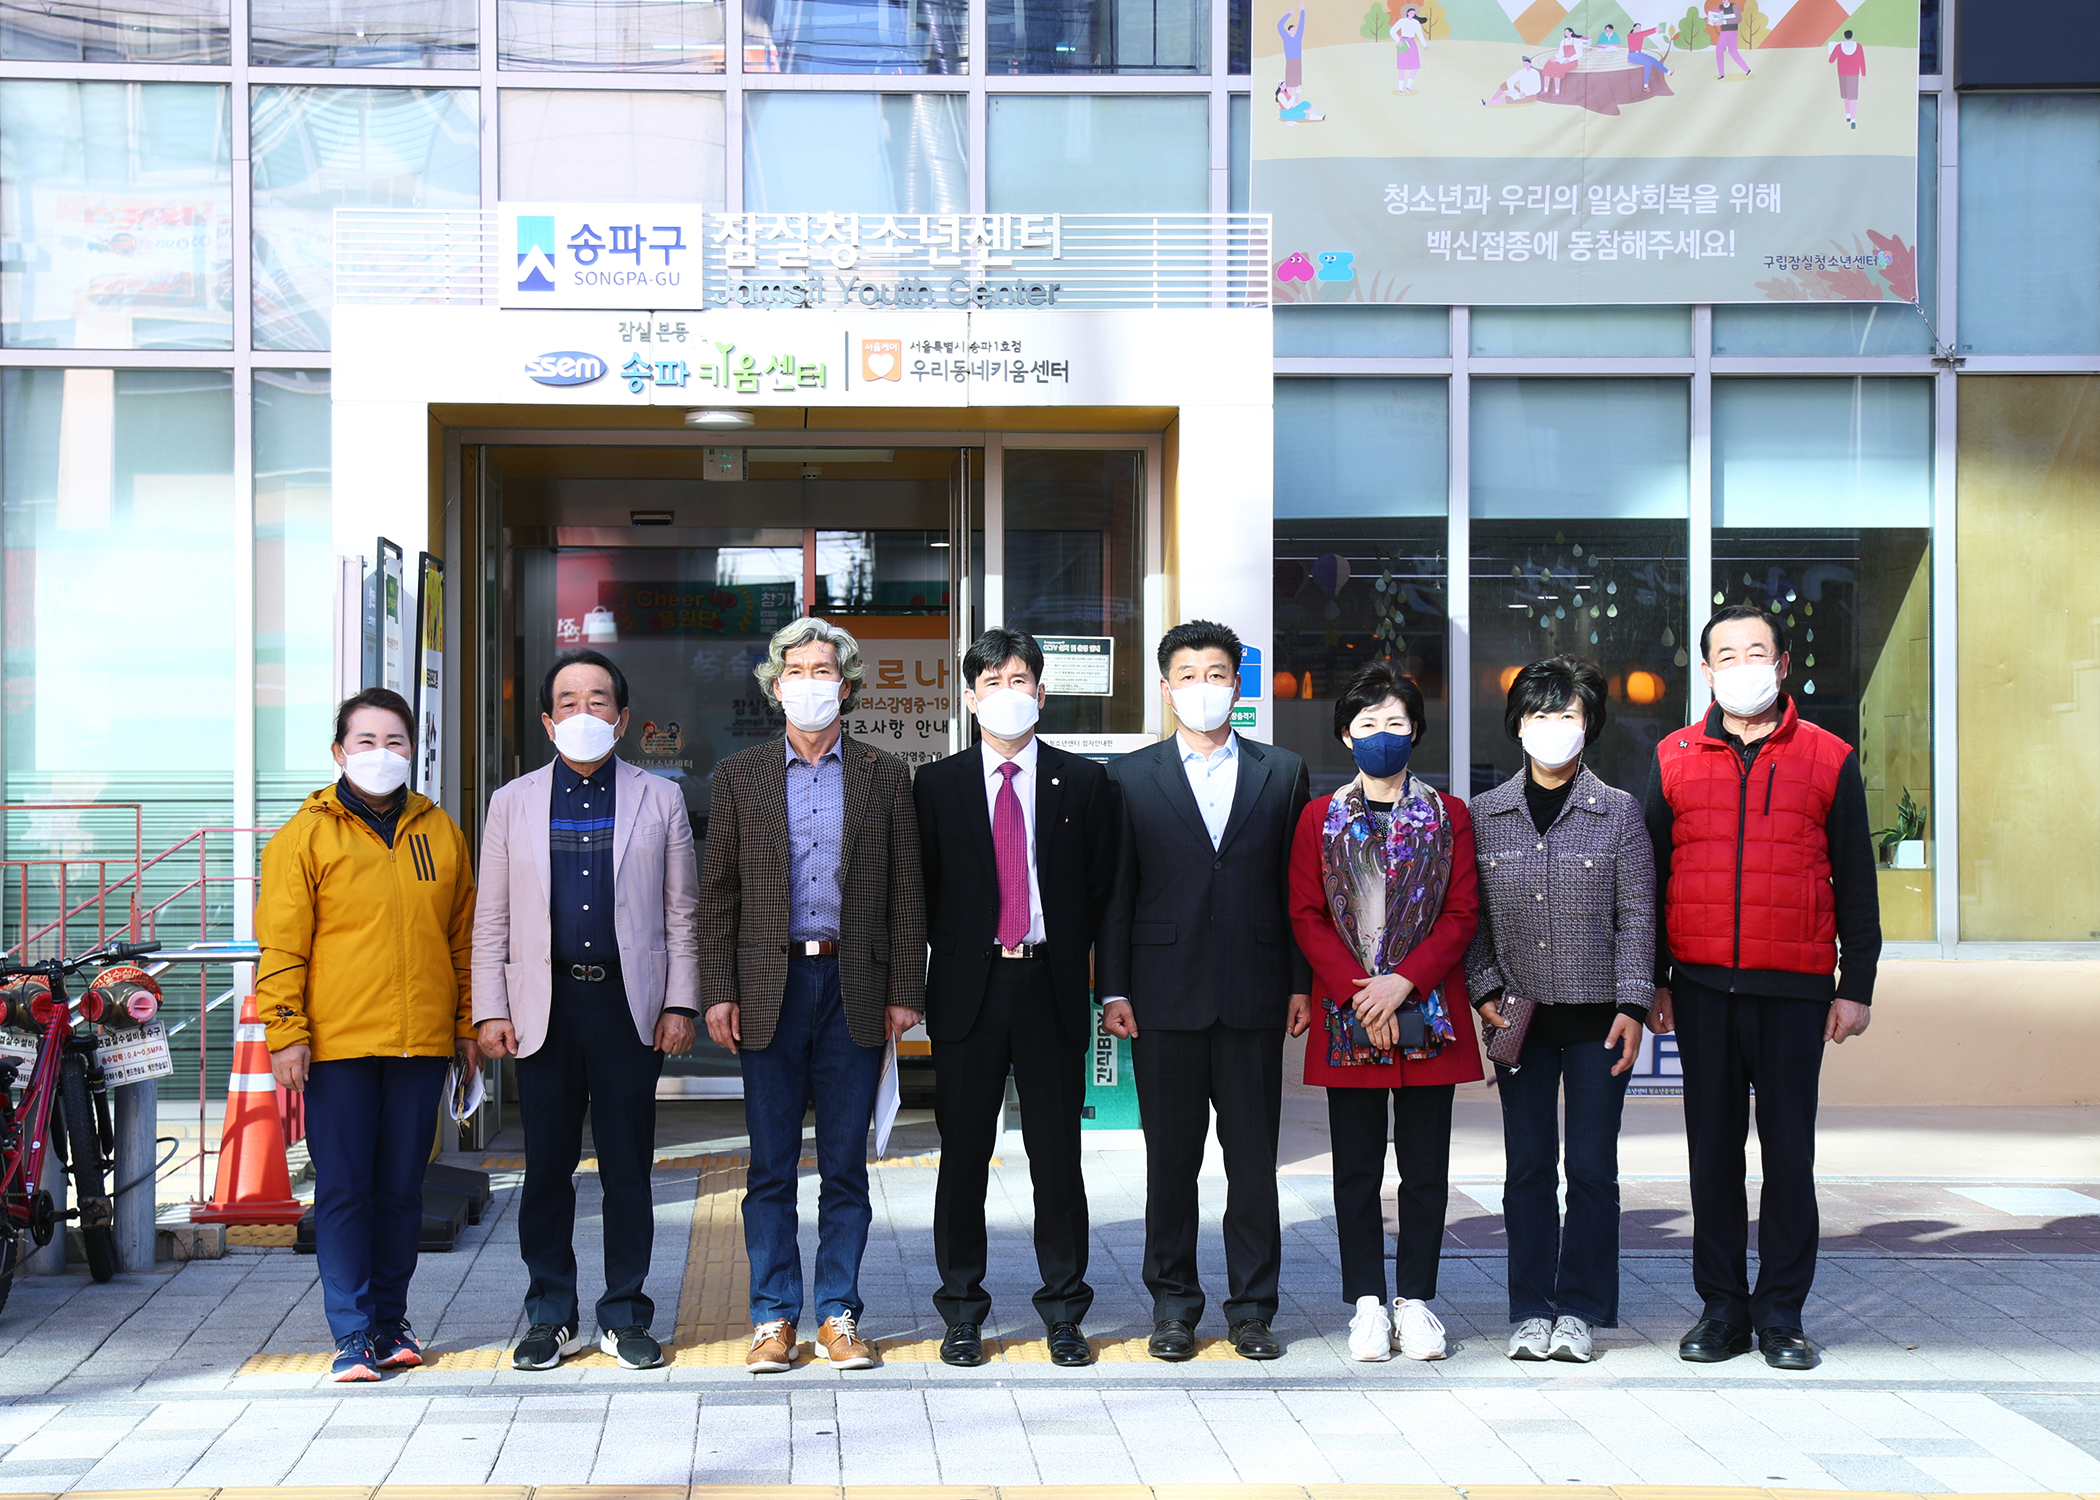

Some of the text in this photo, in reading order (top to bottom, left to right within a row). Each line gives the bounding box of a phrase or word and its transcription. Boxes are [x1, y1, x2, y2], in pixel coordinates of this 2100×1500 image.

[1382, 183, 1781, 215] 청소년과 우리의 일상회복을 위해
[566, 224, 687, 266] 송파구
[712, 211, 1061, 269] 잠실청소년센터
[1426, 230, 1735, 262] 백신접종에 동참해주세요!
[1763, 253, 1879, 271] 구립잠실청소년센터
[574, 270, 680, 287] SONGPA-GU
[714, 276, 1061, 306] Jamsil Youth Center
[618, 321, 689, 343] 잠실 본동
[864, 342, 898, 352] 서울케어
[910, 340, 966, 354] 서울특별시
[620, 351, 691, 393] 송파
[909, 359, 1070, 384] 우리동네키움센터
[636, 588, 737, 611] Cheer up
[859, 659, 950, 689] 로나
[732, 717, 764, 727] Jamsil
[915, 719, 949, 739] 안내
